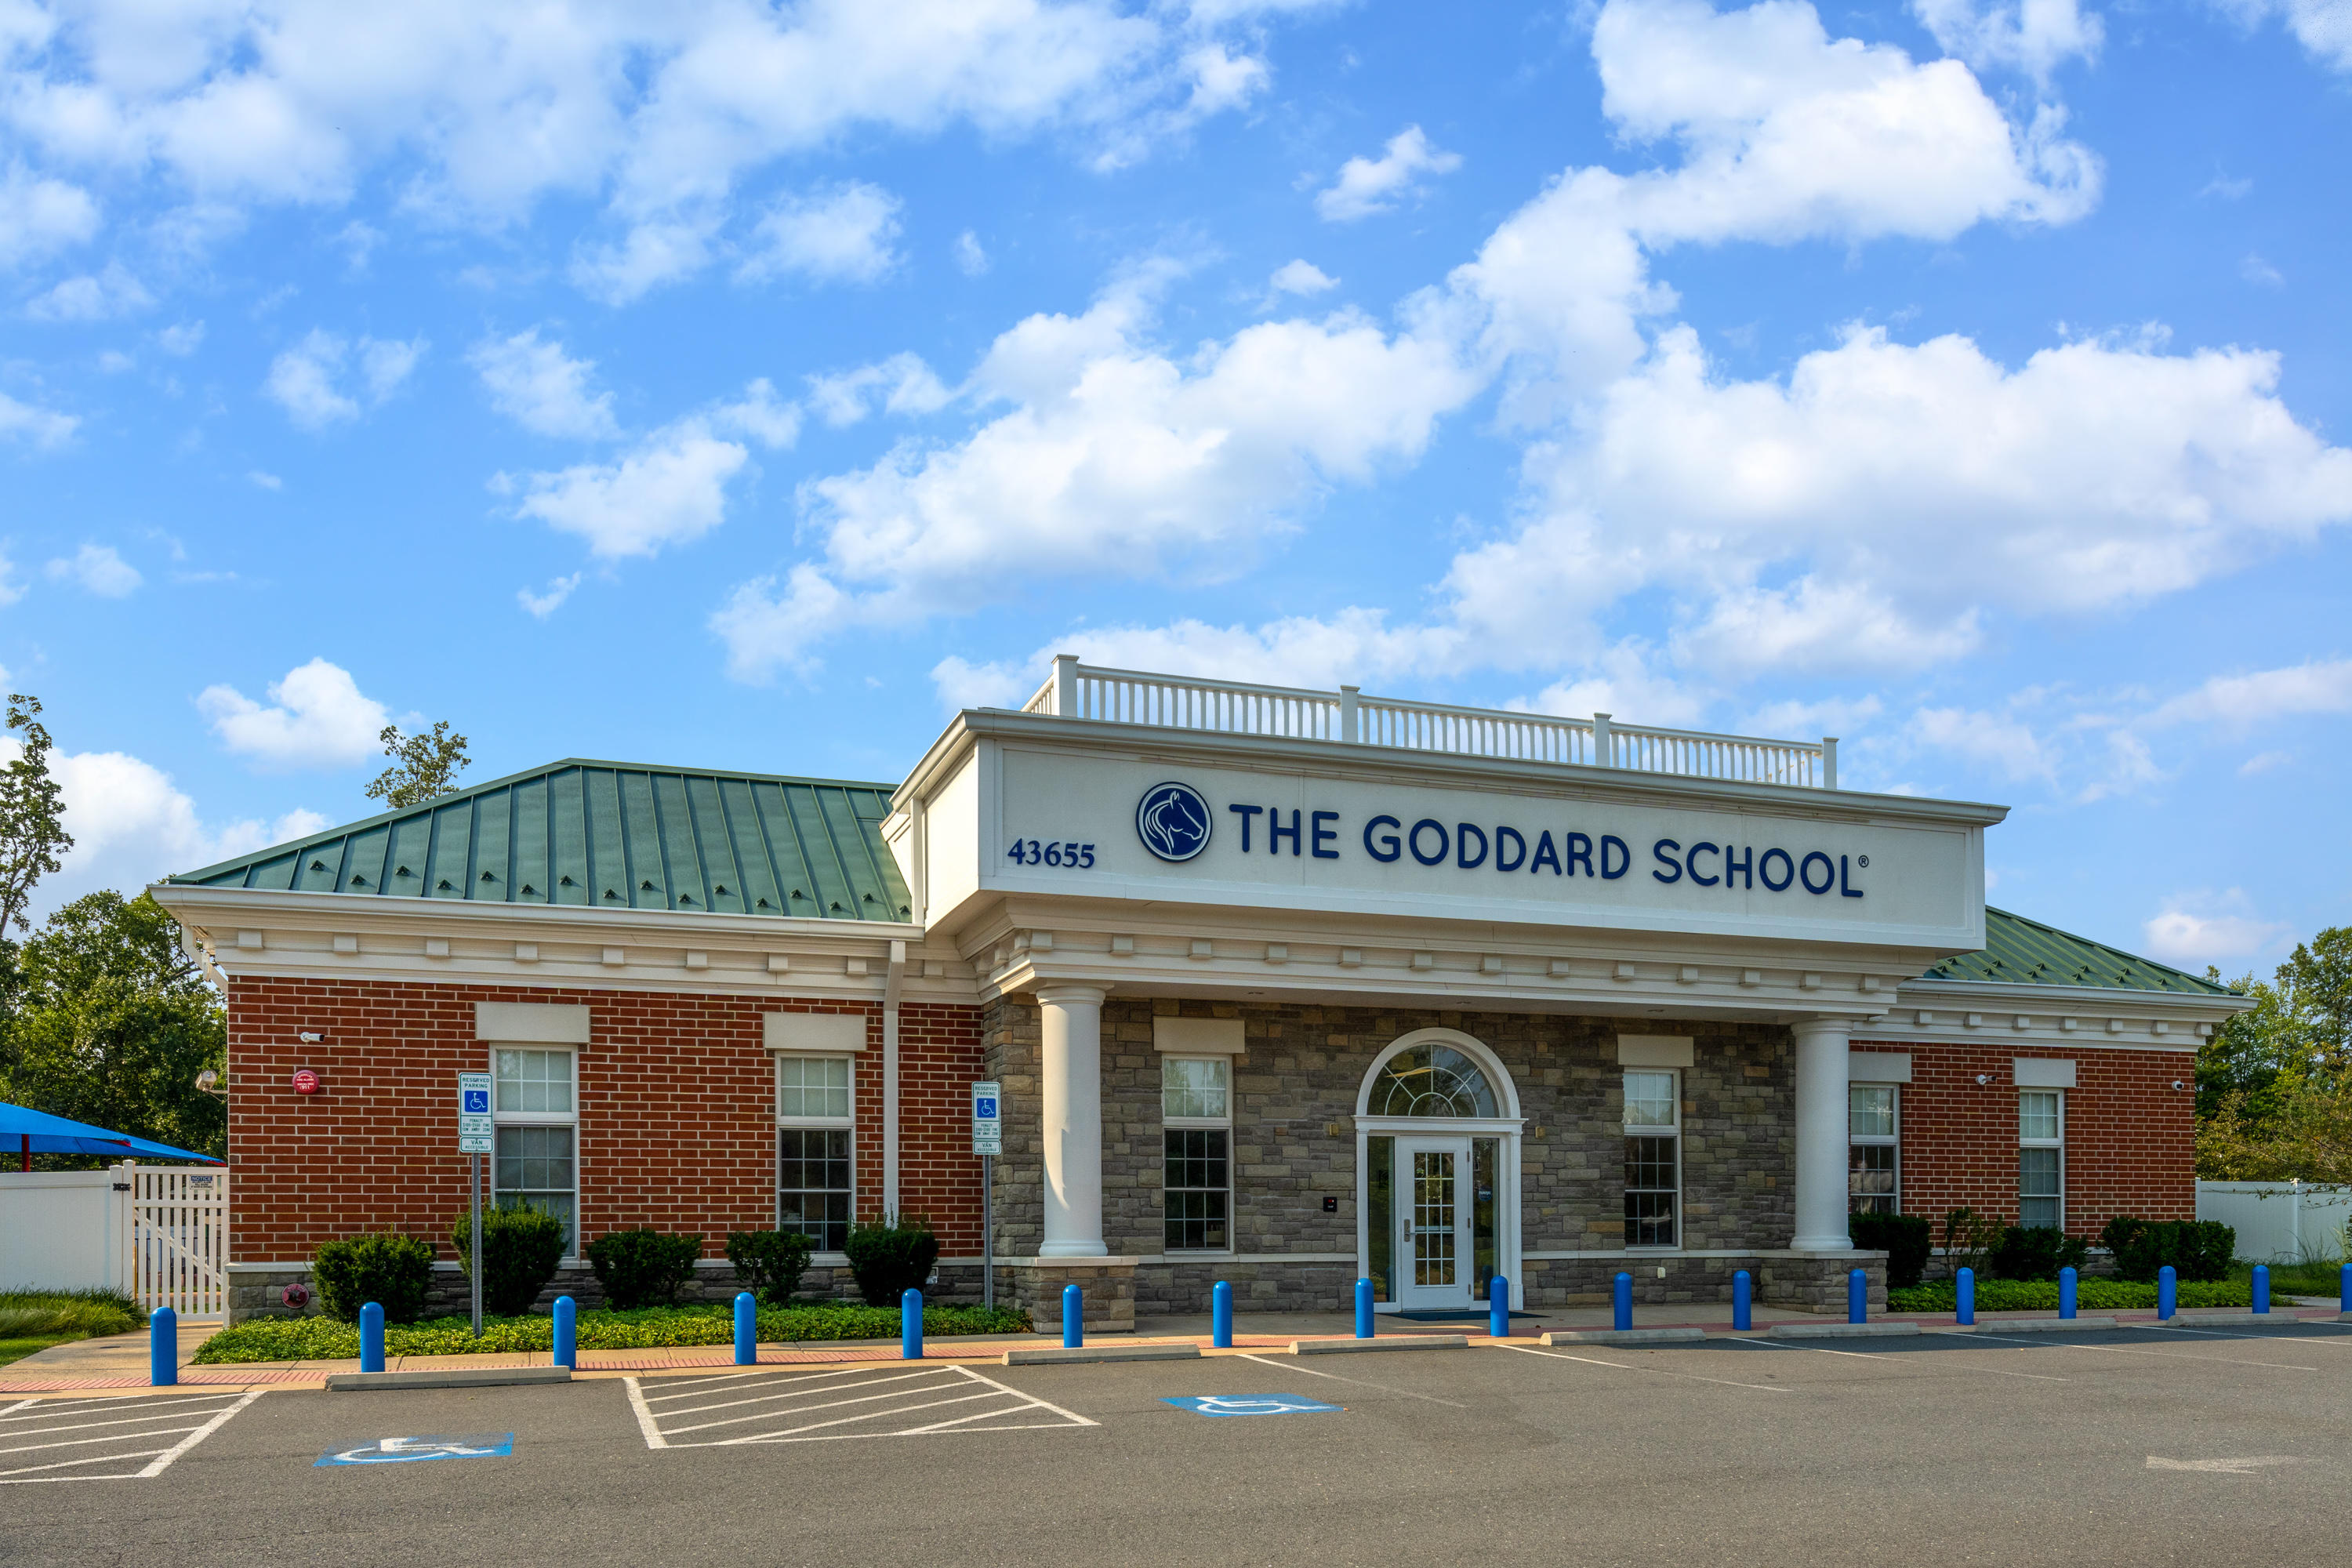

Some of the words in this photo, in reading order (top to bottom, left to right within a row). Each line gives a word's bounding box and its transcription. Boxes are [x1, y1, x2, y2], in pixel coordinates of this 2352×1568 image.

[1007, 837, 1095, 869] 43655
[1229, 804, 1341, 860] THE
[1363, 814, 1632, 881] GODDARD
